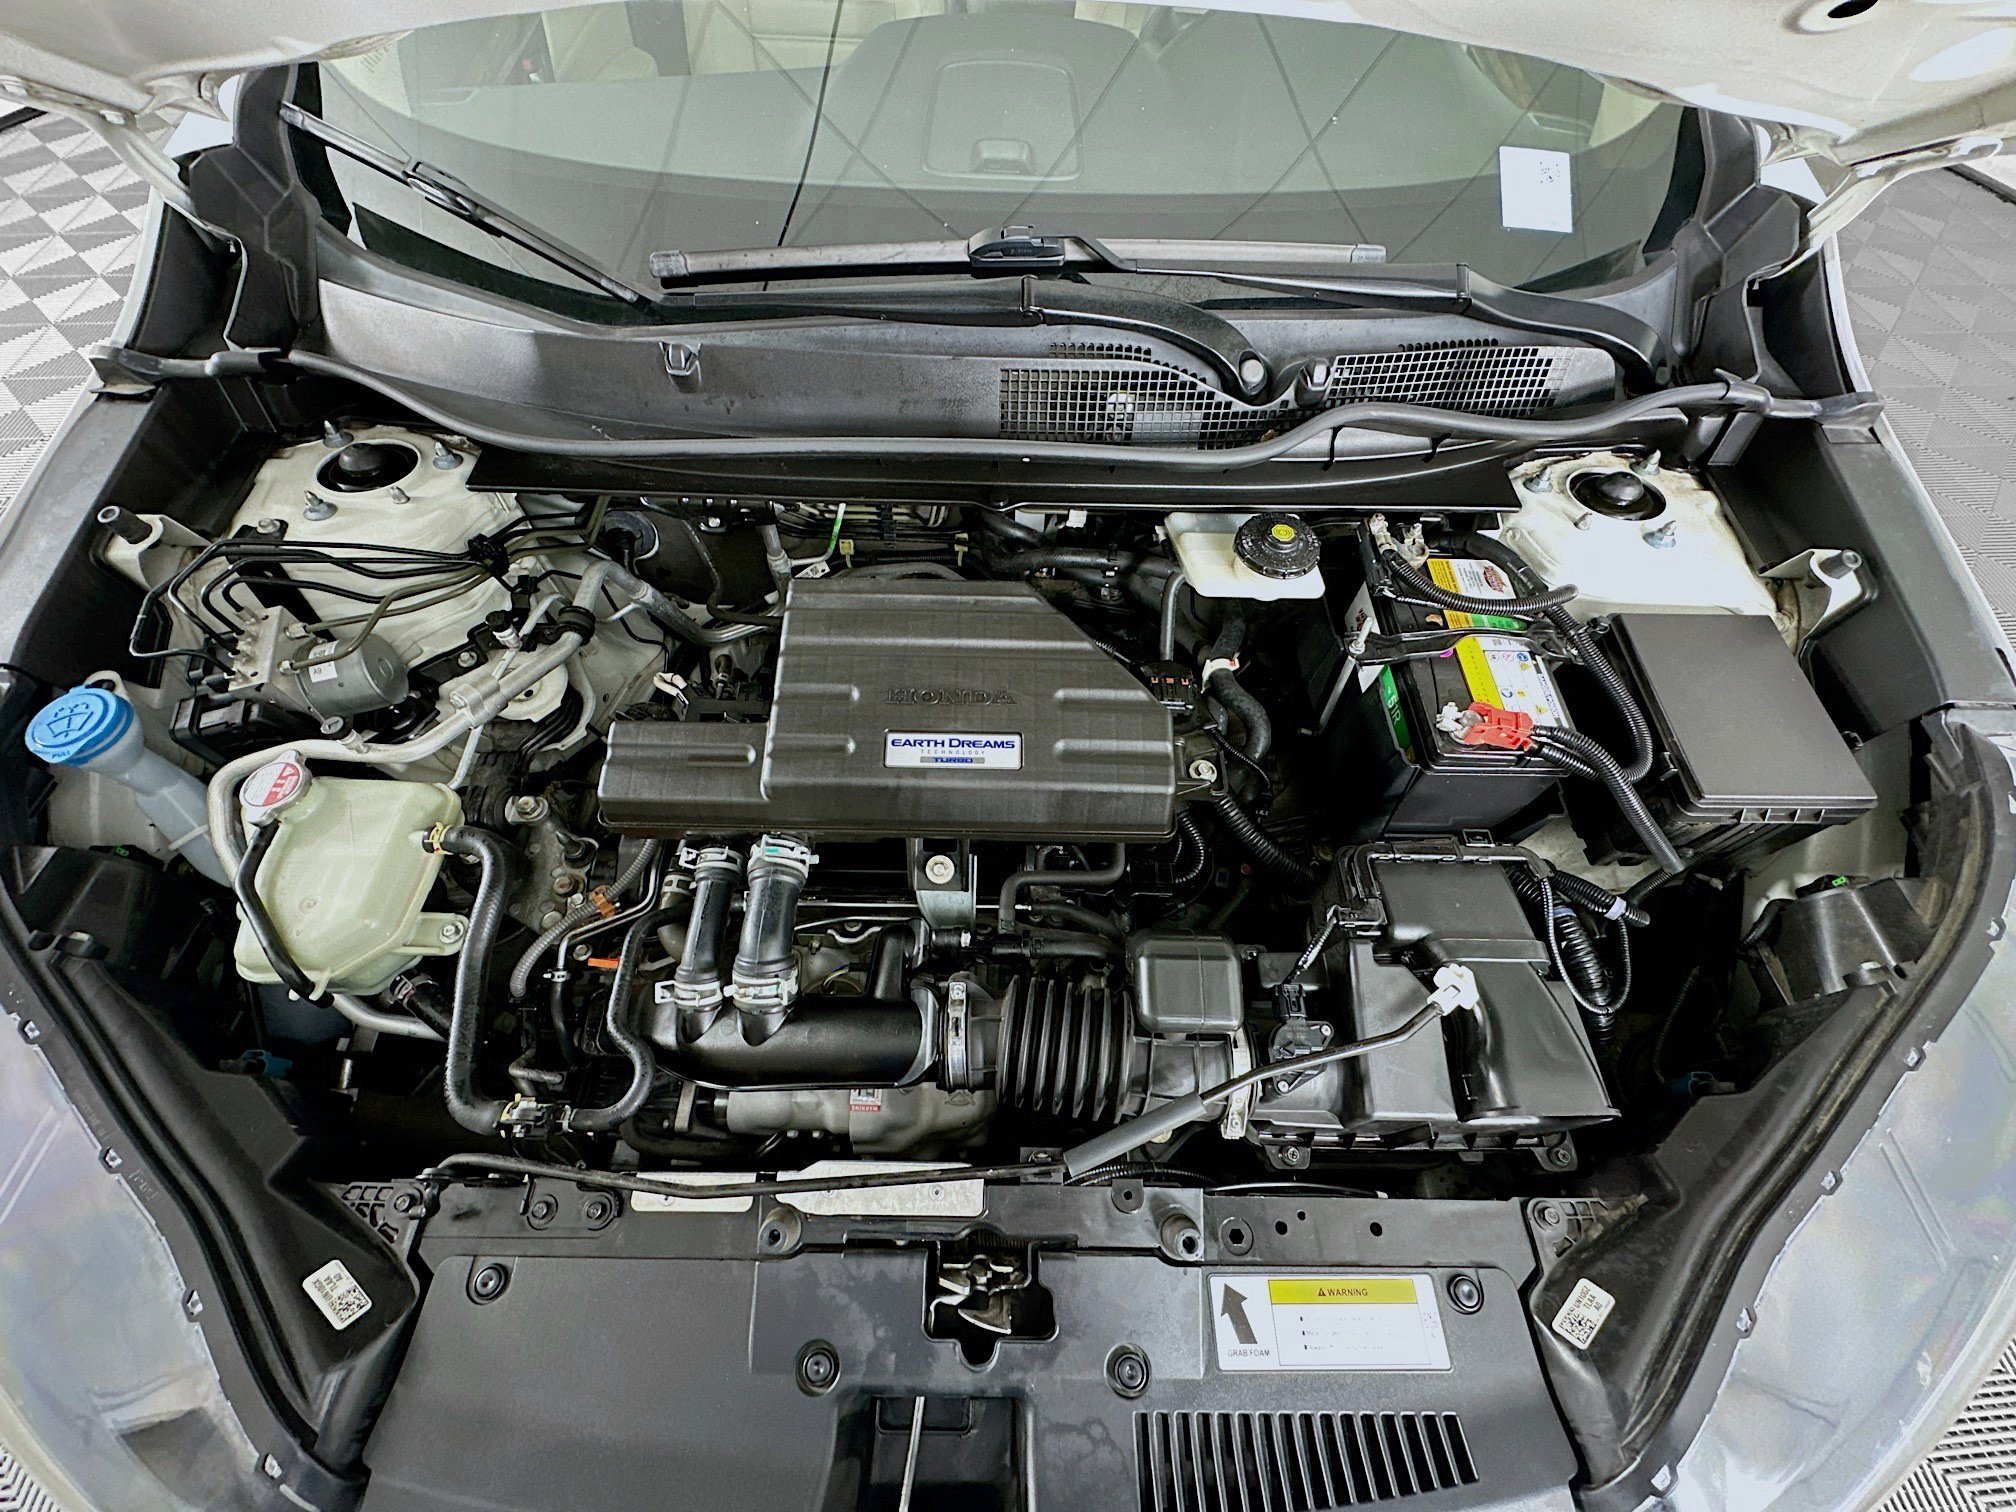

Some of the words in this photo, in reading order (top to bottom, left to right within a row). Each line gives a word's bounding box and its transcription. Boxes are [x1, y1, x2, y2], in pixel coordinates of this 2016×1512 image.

[885, 688, 1018, 705] HONDA
[1387, 695, 1401, 725] 51R
[891, 738, 945, 748] EARTH
[948, 738, 1015, 749] DREAMS
[1327, 1288, 1368, 1297] WARNING
[1227, 1349, 1249, 1357] GRAB
[1250, 1349, 1271, 1357] FOAM
